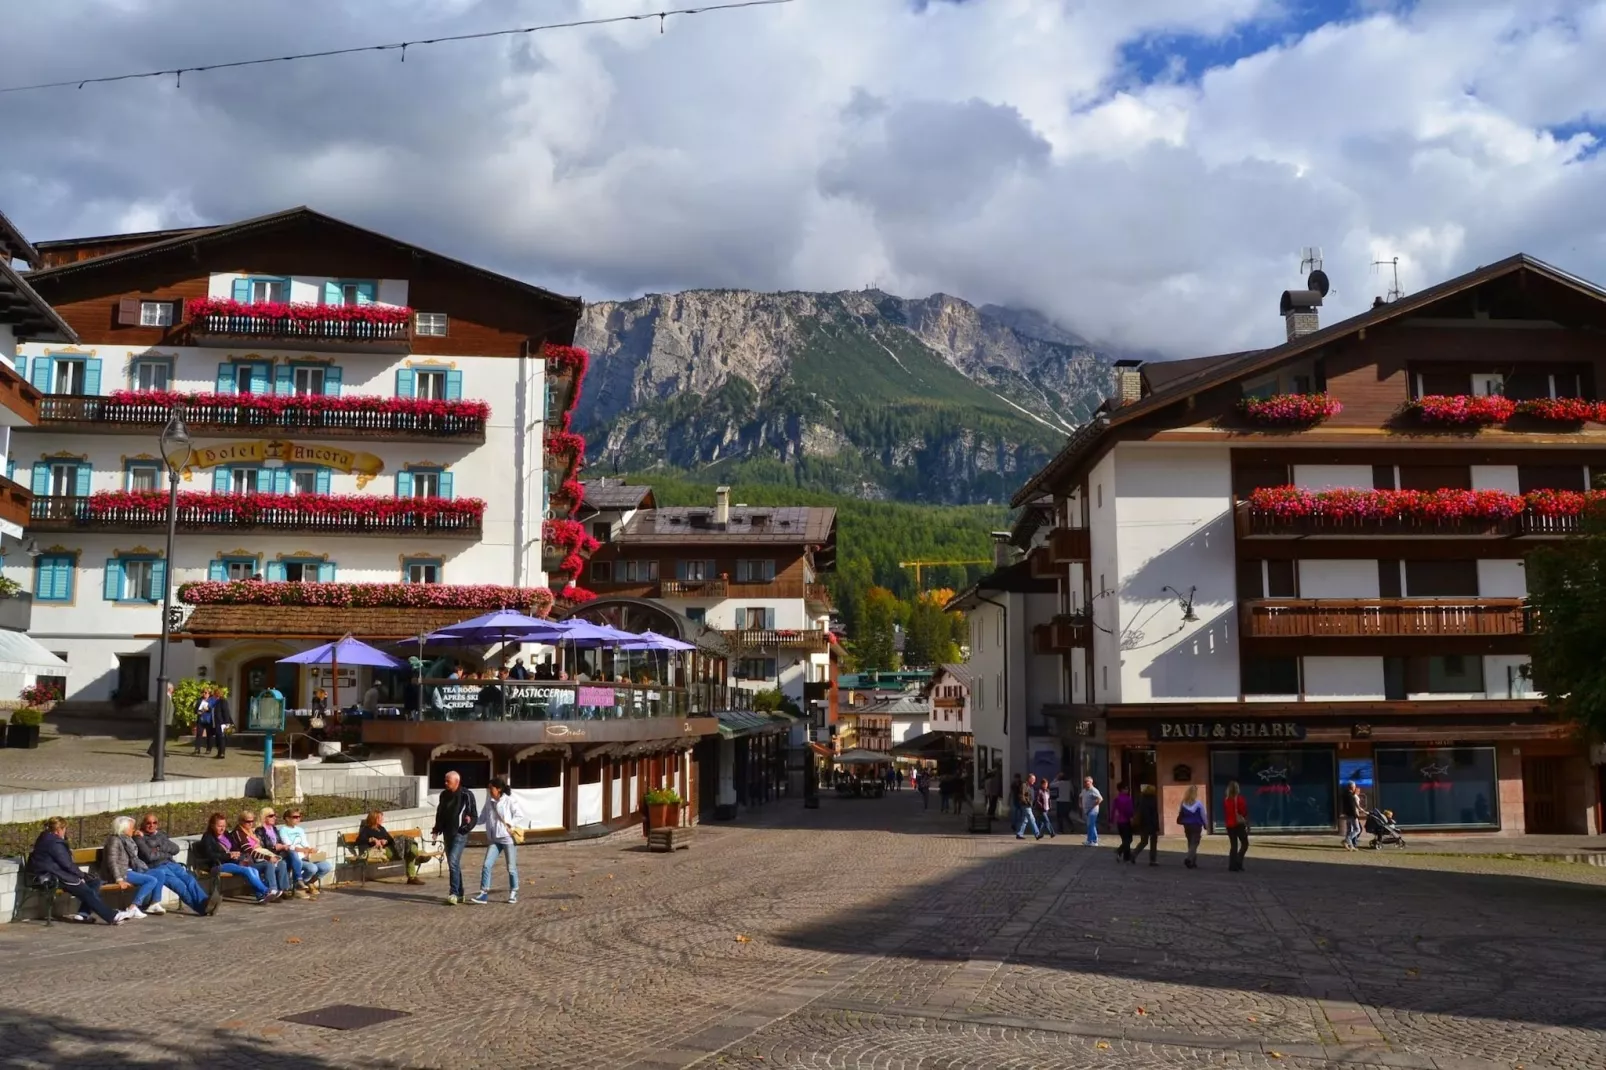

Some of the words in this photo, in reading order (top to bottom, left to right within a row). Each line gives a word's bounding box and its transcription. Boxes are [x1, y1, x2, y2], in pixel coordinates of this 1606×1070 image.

[205, 445, 255, 462] Hotel
[294, 445, 348, 465] Ancora
[512, 688, 568, 698] PASTICCERIA
[1161, 723, 1207, 737] PAUL
[1212, 722, 1226, 737] &
[1230, 722, 1298, 737] SHARK
